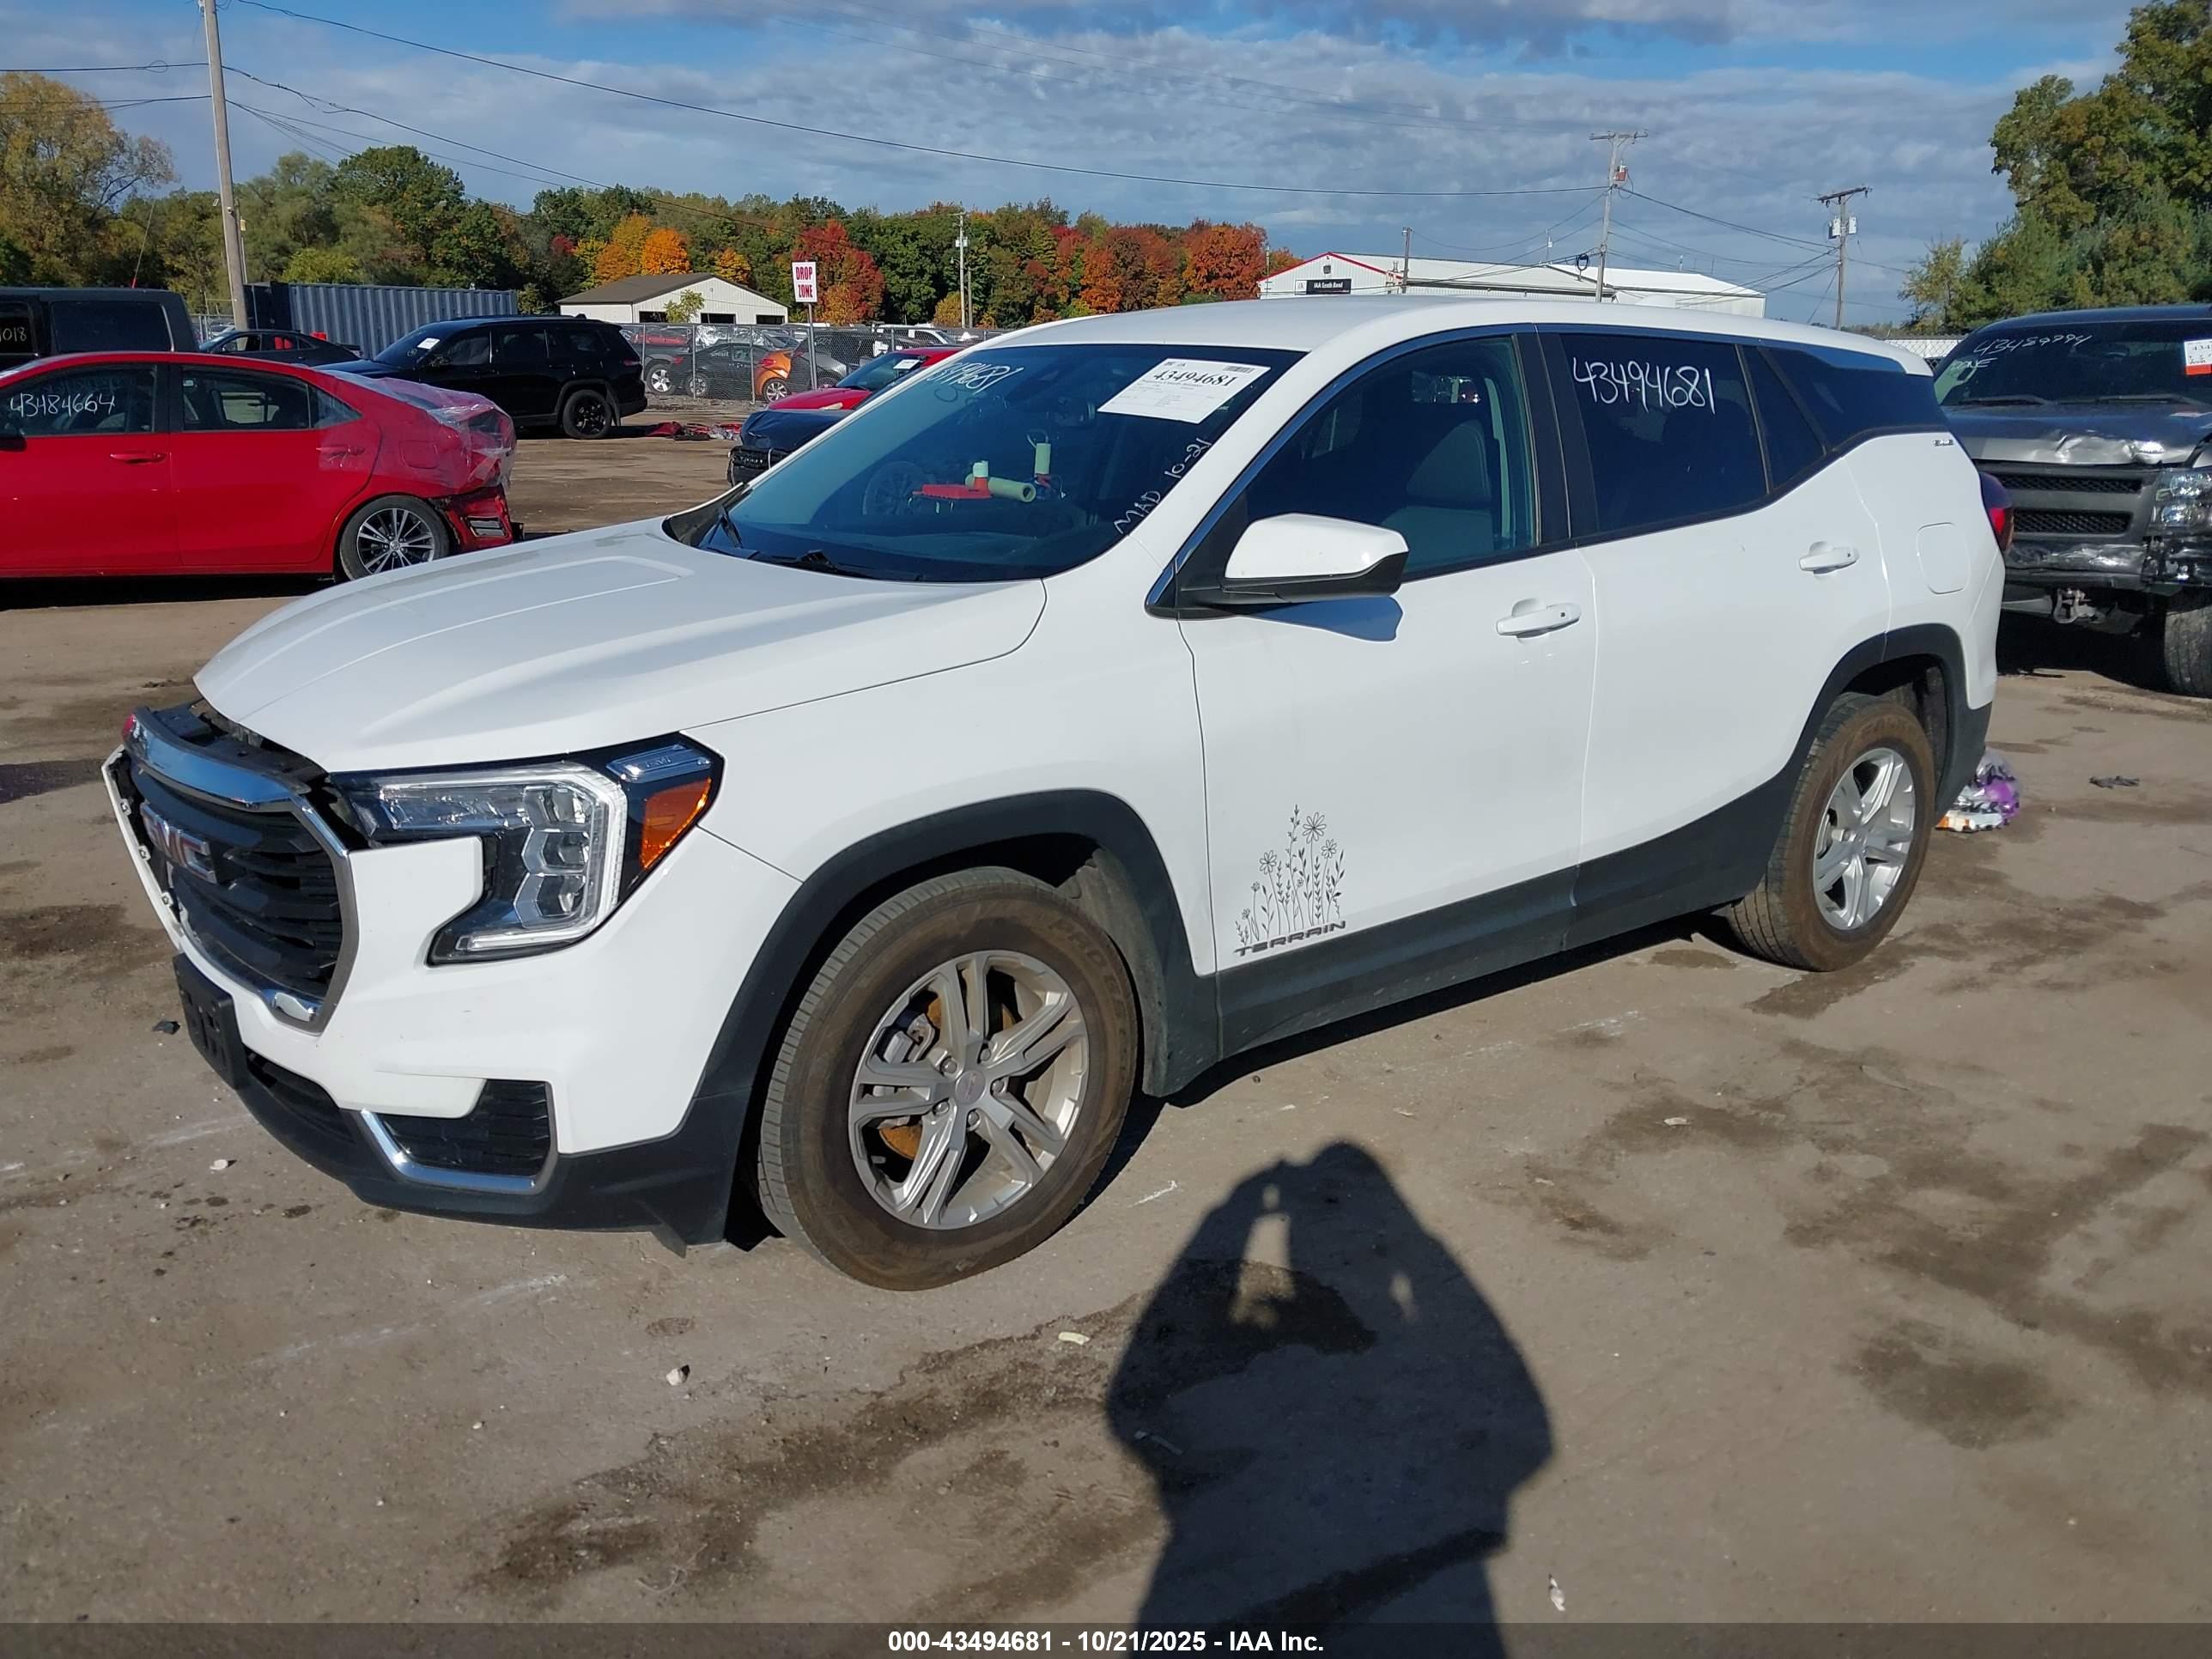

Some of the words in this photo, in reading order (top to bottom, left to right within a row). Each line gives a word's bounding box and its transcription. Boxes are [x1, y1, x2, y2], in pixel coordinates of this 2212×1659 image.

[796, 266, 813, 280] DROP
[798, 284, 813, 298] ZONE
[1153, 369, 1239, 386] 43494681
[1573, 356, 1716, 414] 43494681
[10, 392, 116, 417] 43484664
[1113, 490, 1161, 534] MAD
[1164, 437, 1212, 478] 10-21
[1234, 920, 1346, 957] TERRAIN
